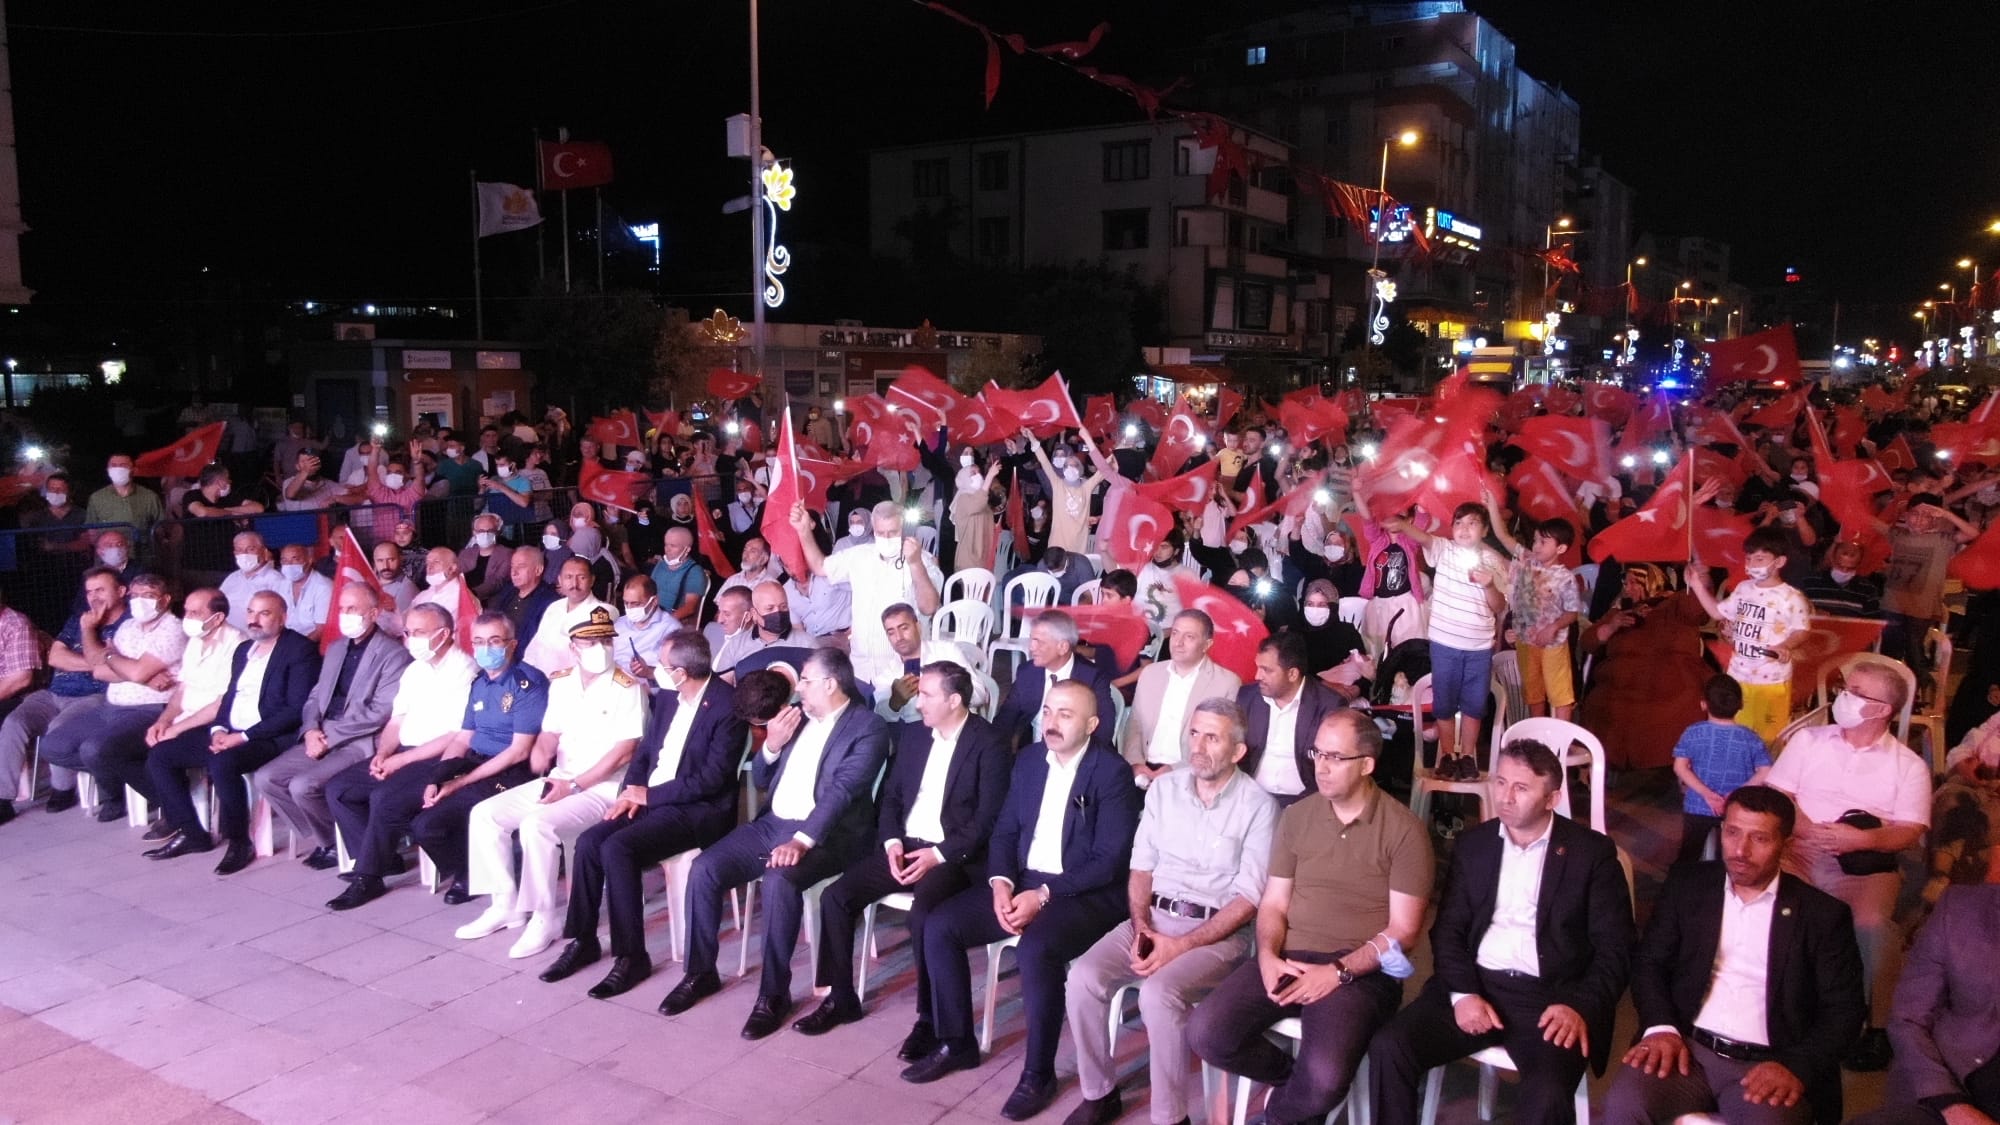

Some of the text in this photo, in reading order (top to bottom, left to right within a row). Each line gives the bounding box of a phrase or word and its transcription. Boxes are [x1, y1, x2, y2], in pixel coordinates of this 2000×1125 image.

[1436, 211, 1453, 230] YURT
[1737, 601, 1766, 620] GOTTA
[1735, 621, 1762, 639] ATCH
